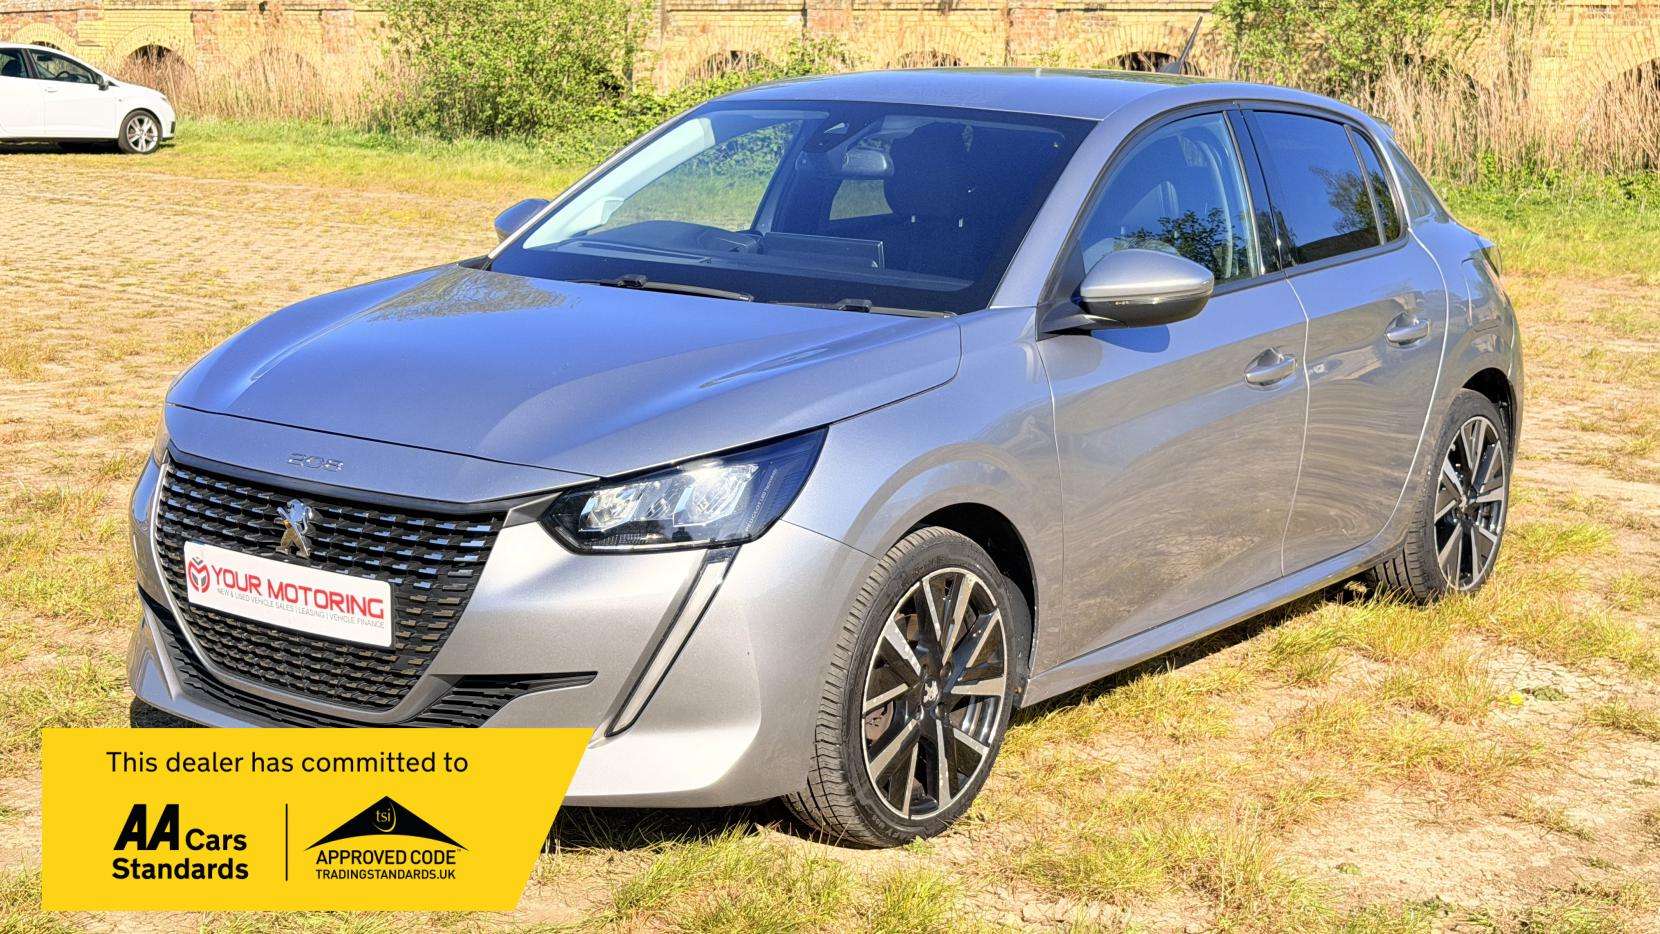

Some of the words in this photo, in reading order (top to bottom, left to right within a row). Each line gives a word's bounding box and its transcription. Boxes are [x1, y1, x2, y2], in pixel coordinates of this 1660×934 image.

[288, 453, 344, 472] 208
[211, 564, 262, 596] YOUR
[267, 578, 385, 619] MOTORING
[275, 601, 294, 613] SALES
